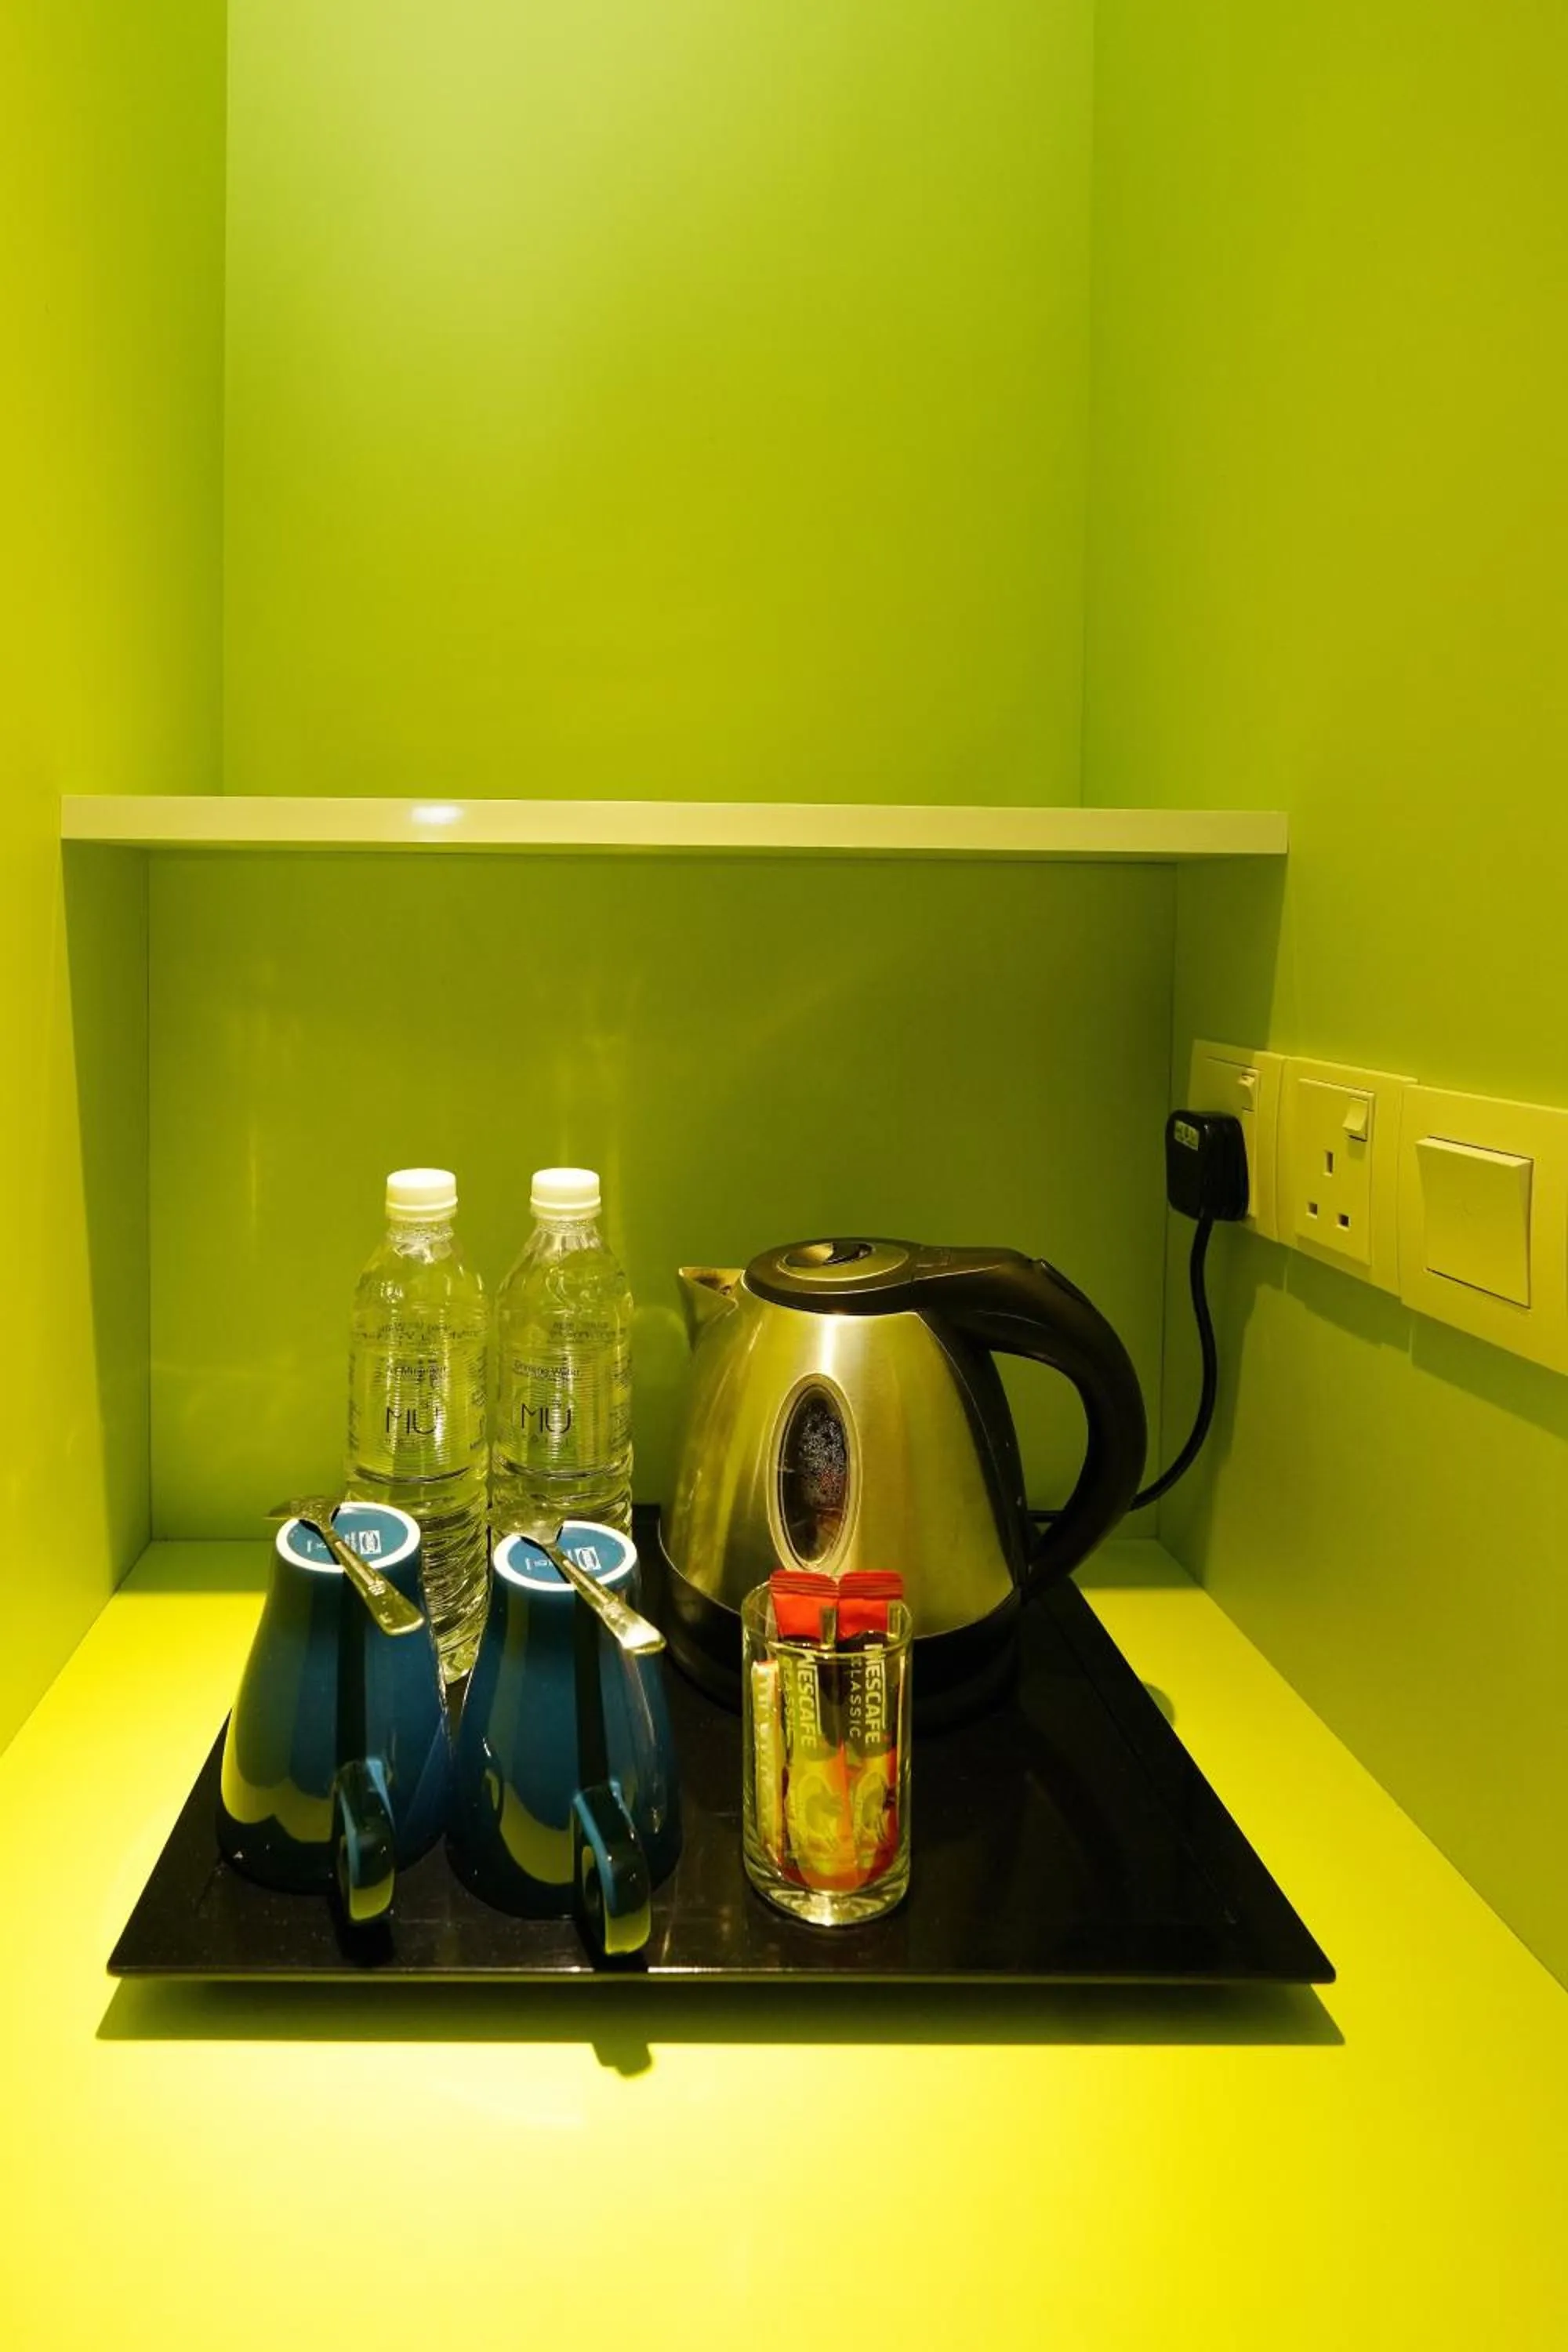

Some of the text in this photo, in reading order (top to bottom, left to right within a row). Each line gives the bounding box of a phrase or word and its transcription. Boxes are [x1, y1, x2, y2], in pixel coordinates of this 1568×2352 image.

[386, 1406, 439, 1435] MU
[521, 1403, 572, 1434] MU
[849, 1655, 862, 1739] CLASSIC
